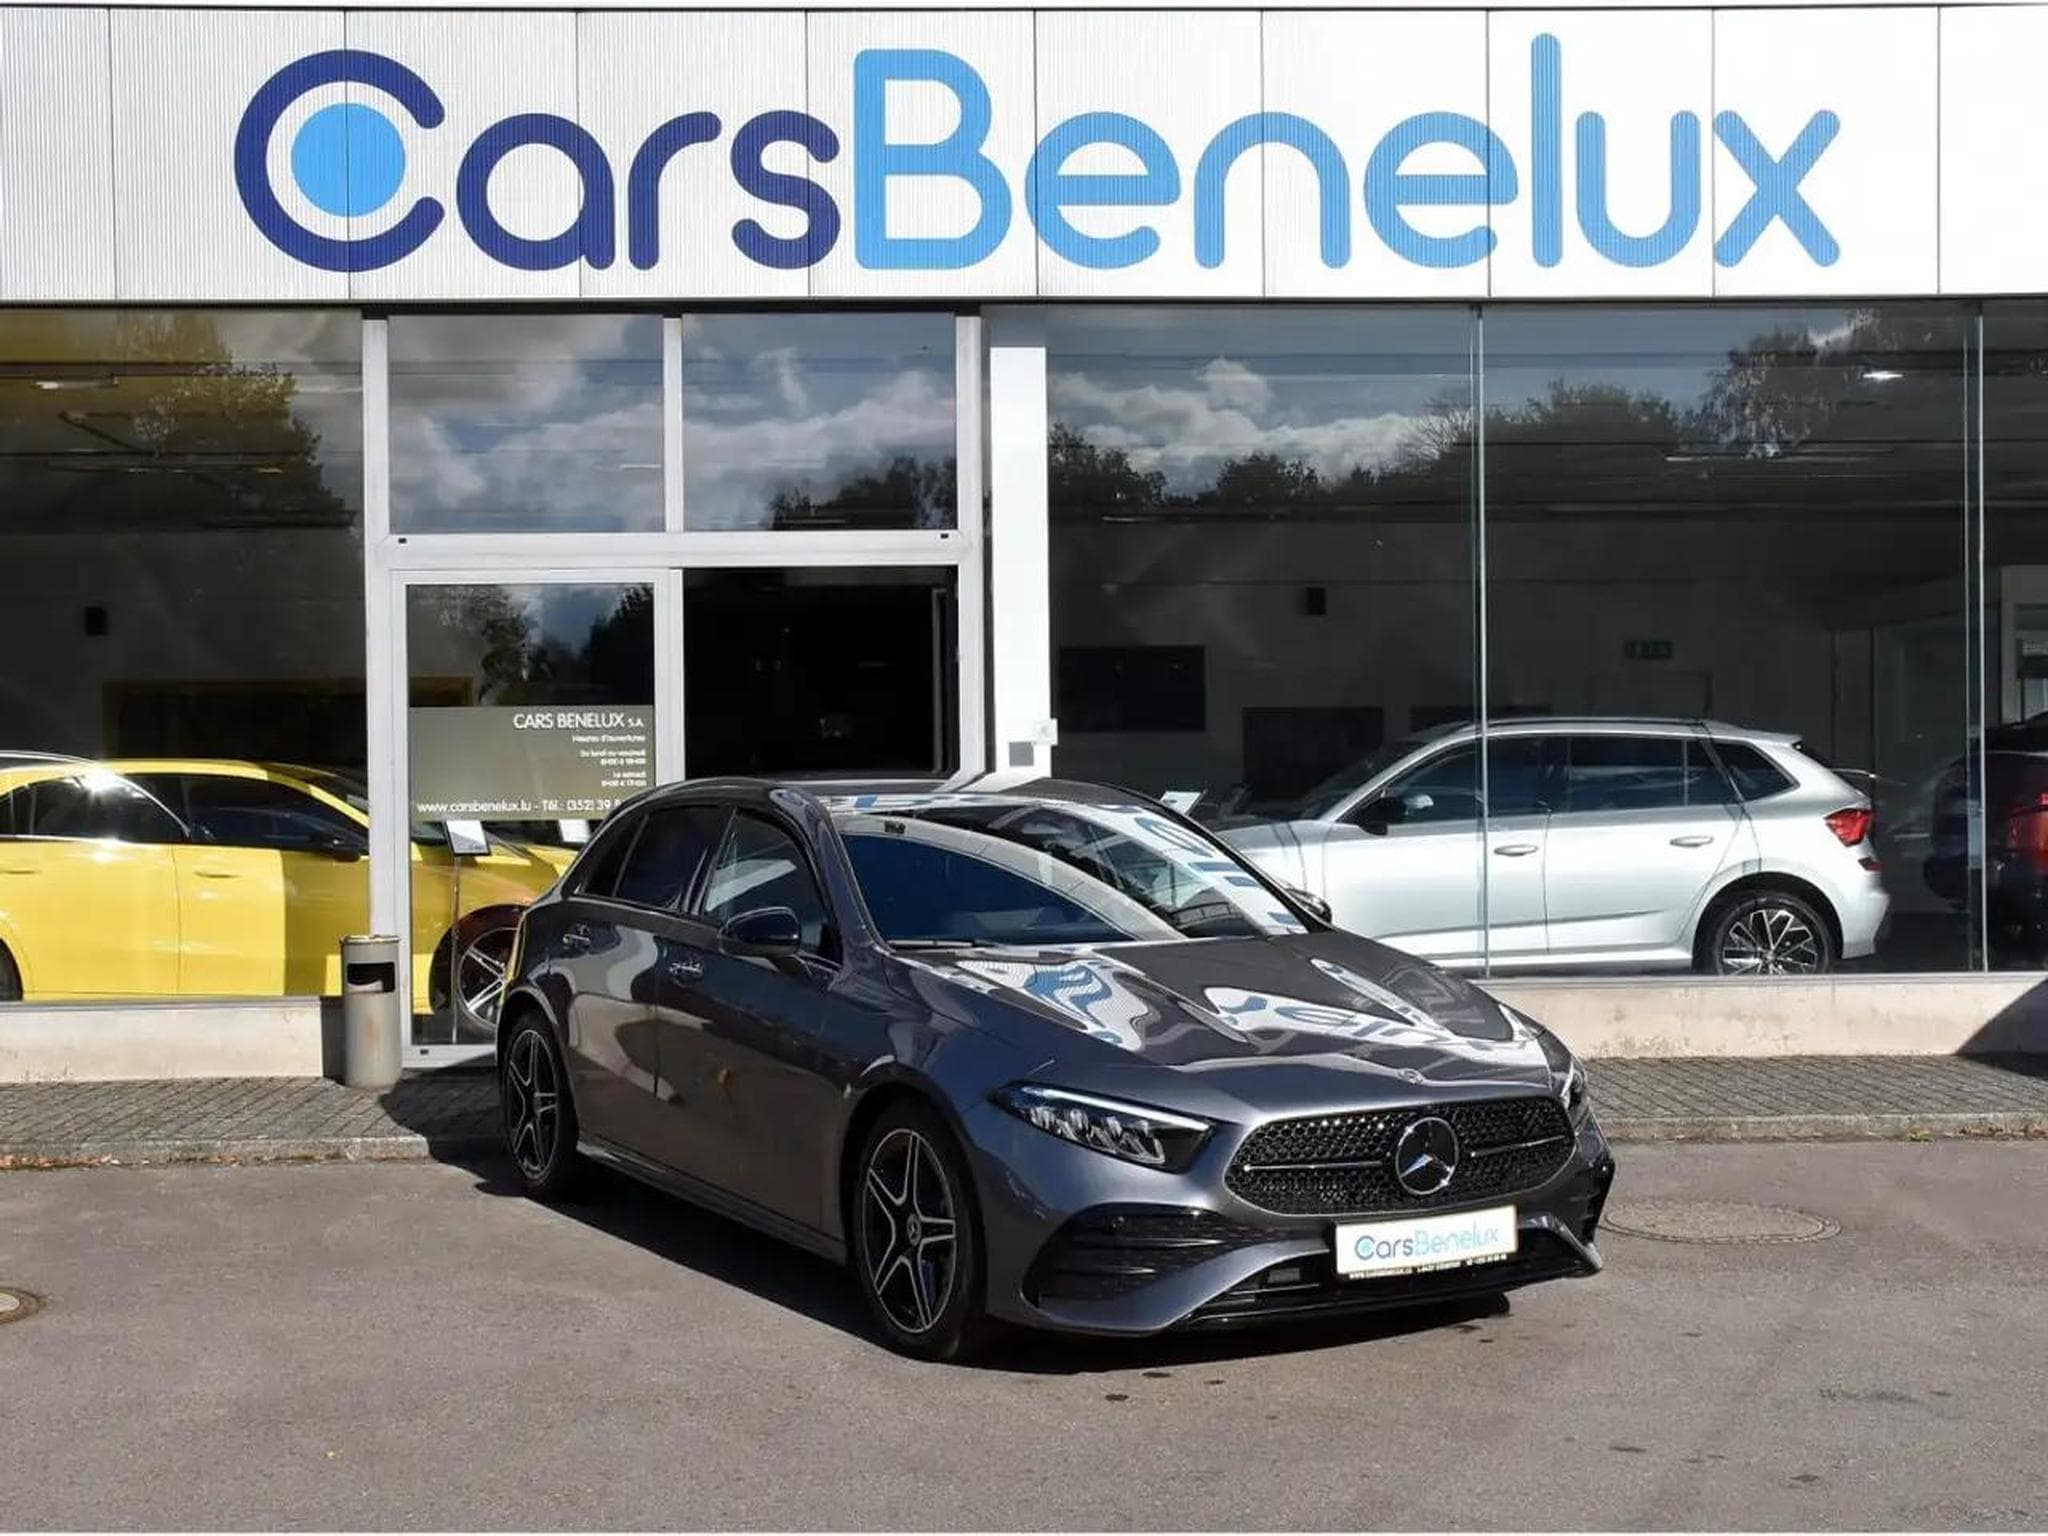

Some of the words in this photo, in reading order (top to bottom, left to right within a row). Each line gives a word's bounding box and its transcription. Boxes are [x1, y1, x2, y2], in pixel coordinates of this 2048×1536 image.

[234, 33, 1841, 272] CarsBenelux
[513, 712, 554, 729] CARS
[557, 712, 625, 729] BENELUX
[417, 799, 532, 812] www.carsbenelux.lu
[1354, 1219, 1499, 1260] CarsBenelux
